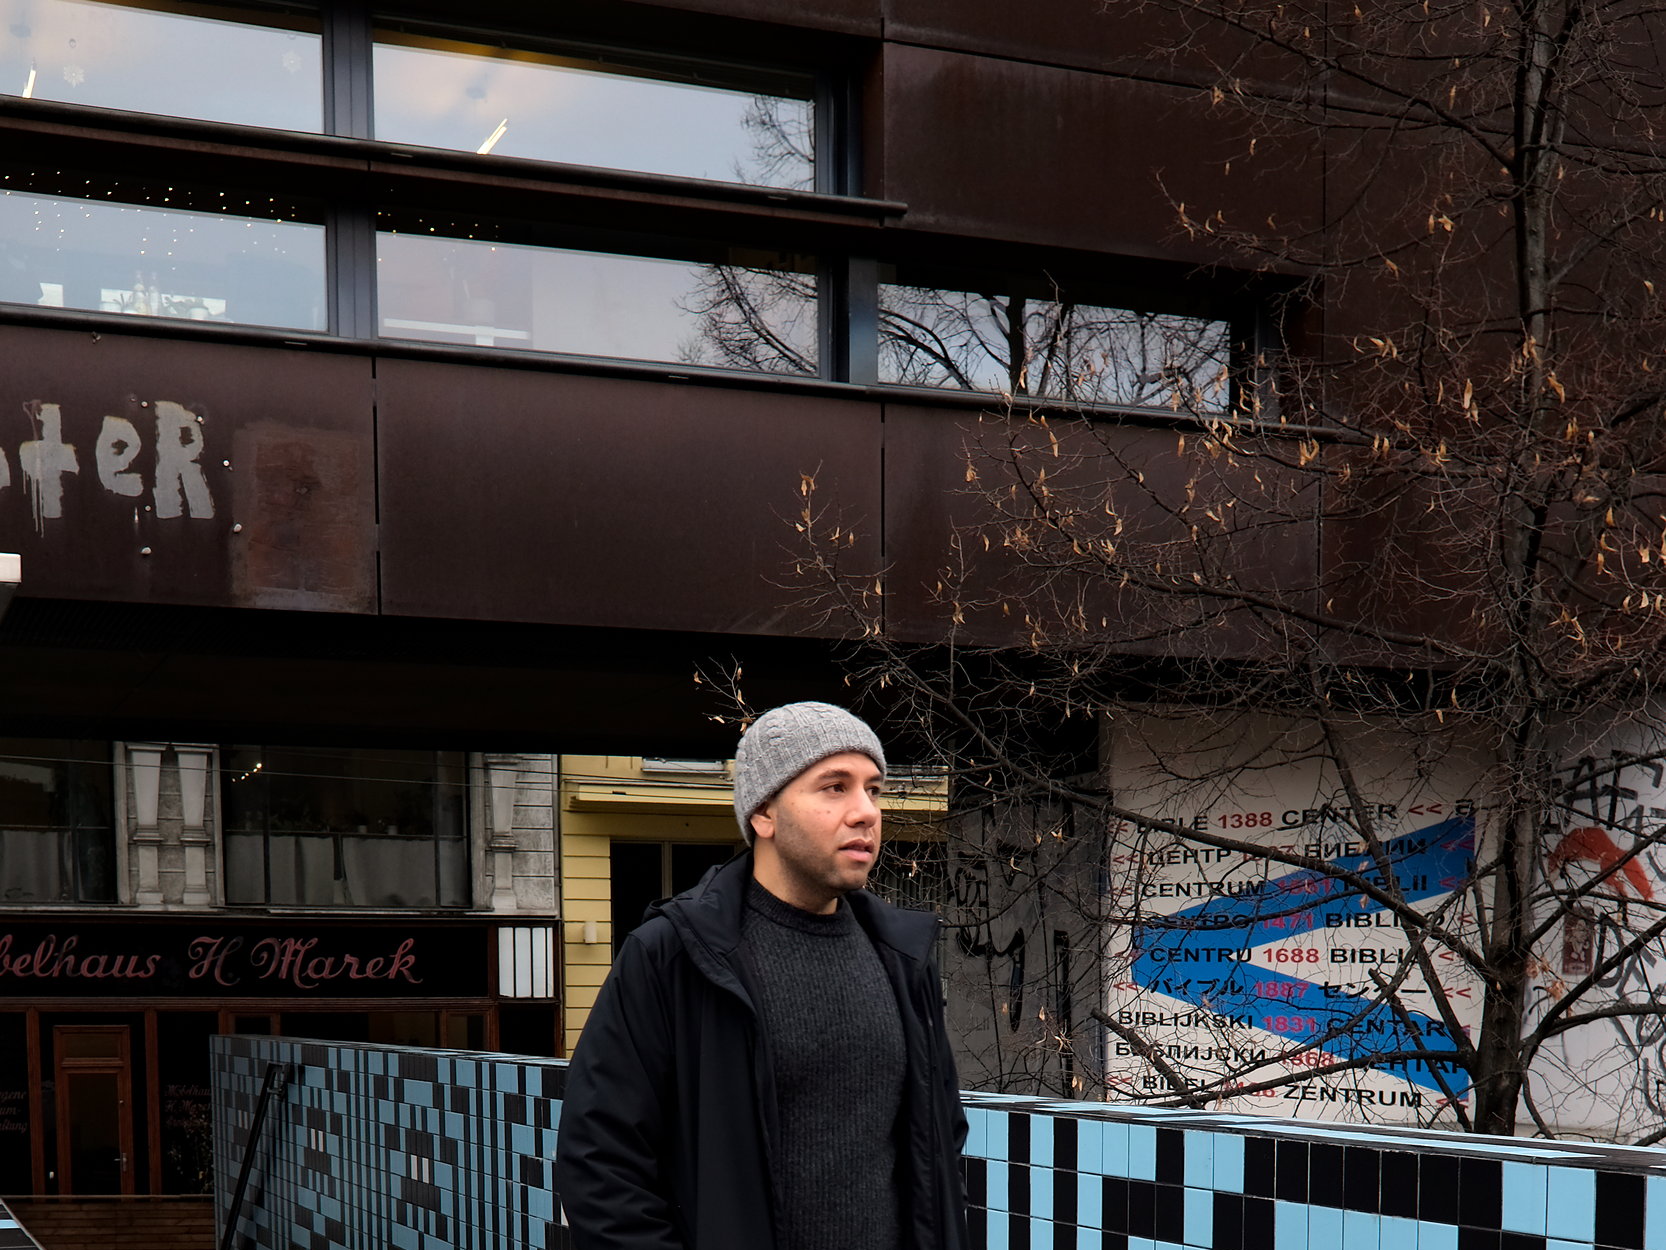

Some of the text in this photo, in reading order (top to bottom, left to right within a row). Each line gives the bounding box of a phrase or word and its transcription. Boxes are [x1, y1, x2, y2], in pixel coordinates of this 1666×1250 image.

[1218, 811, 1273, 829] 1388
[1143, 880, 1265, 898] CENTRUM
[1262, 912, 1314, 929] 1471
[1325, 912, 1445, 929] BIBLIO
[250, 936, 424, 990] Marek
[1150, 947, 1419, 964] CENTRU 1688 BIBLI
[1150, 977, 1244, 996] バイブル
[1255, 981, 1310, 999] 1887
[1262, 1014, 1317, 1033] 1831
[1283, 1084, 1423, 1108] ZENTRUM
